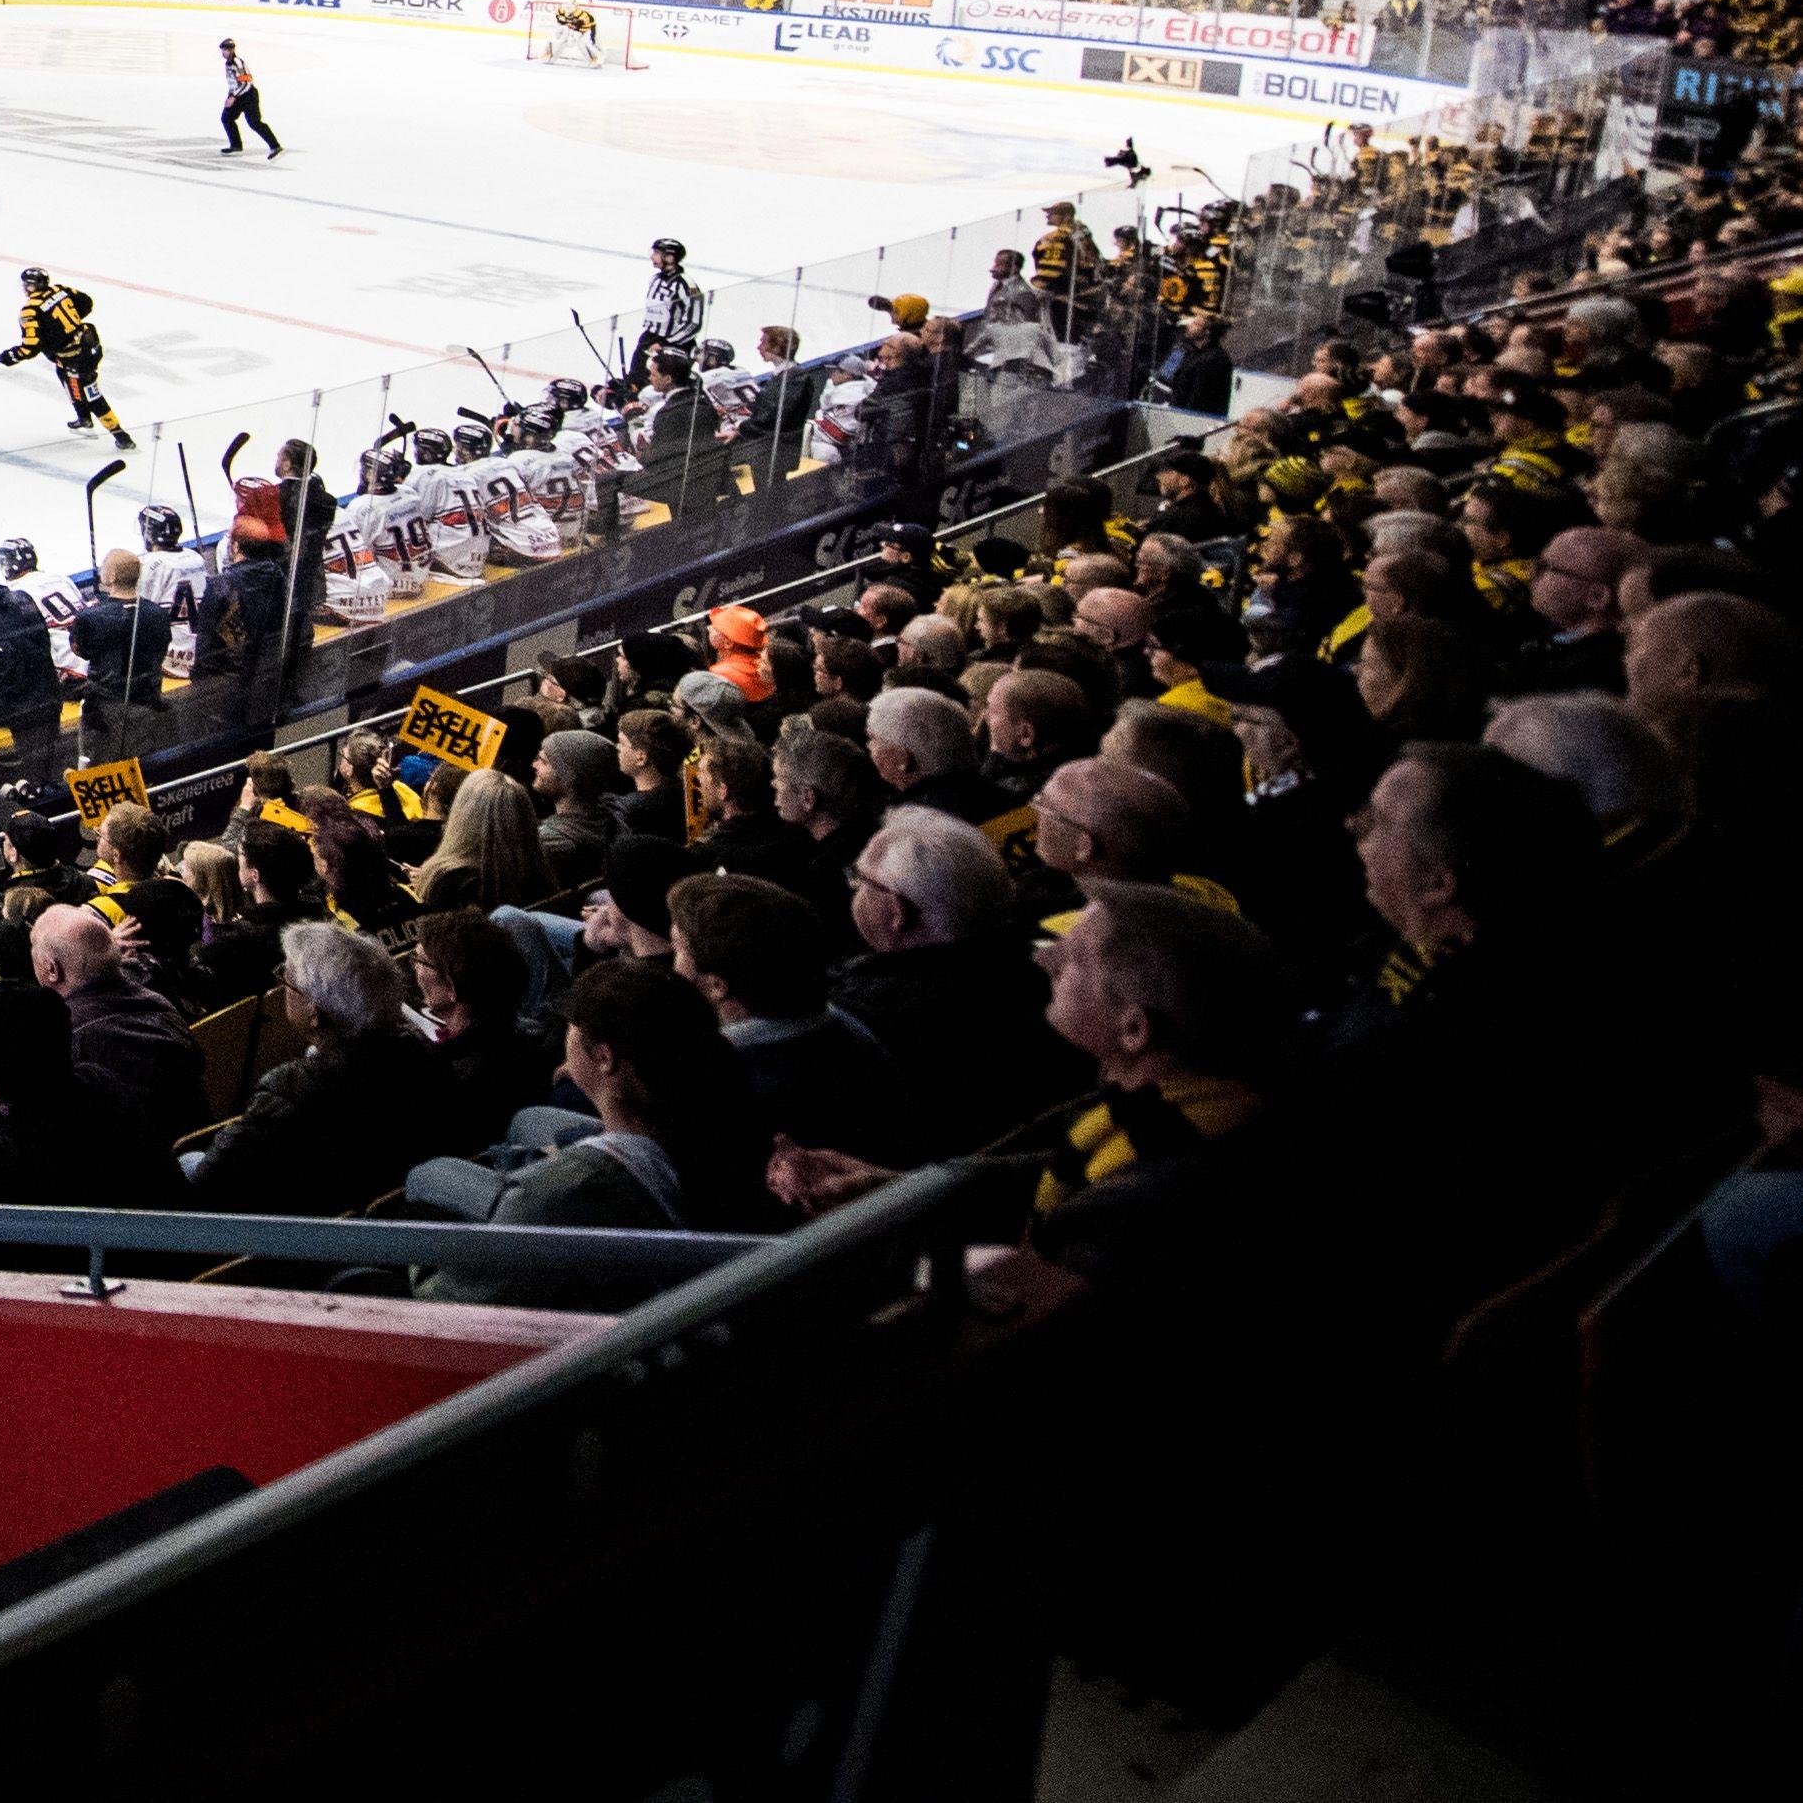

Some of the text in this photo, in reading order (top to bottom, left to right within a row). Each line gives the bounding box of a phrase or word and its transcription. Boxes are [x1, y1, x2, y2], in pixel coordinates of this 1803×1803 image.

[807, 22, 871, 42] LEAB
[833, 43, 870, 53] group
[1165, 16, 1359, 58] Elecosoft
[981, 46, 1041, 73] SSC
[1264, 73, 1399, 114] BOLIDEN
[52, 297, 82, 334] 16
[414, 697, 483, 745] SKELL
[74, 772, 125, 799] SKELL
